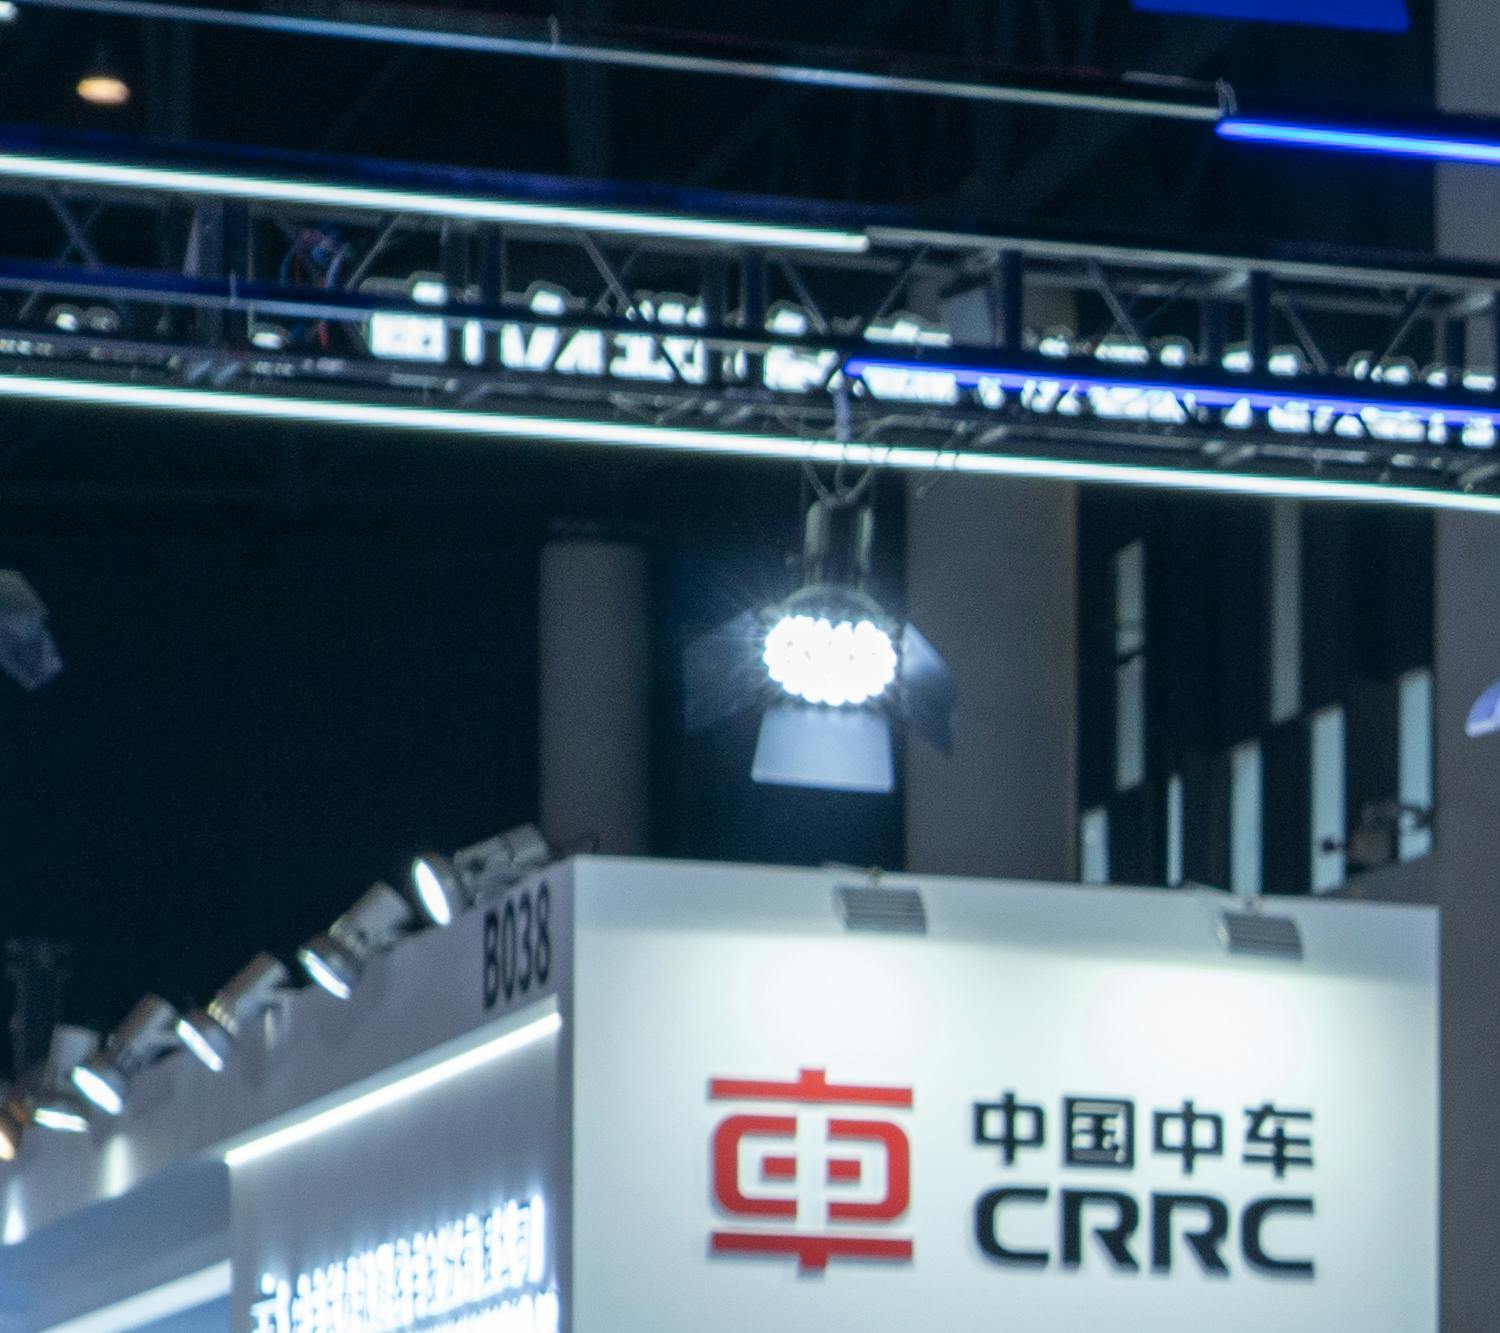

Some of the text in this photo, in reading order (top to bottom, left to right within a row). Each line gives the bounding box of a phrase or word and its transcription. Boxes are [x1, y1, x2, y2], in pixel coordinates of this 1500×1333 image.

[482, 880, 551, 1009] B038
[970, 1092, 1315, 1179] 中国中车
[971, 1184, 1316, 1277] CRRC
